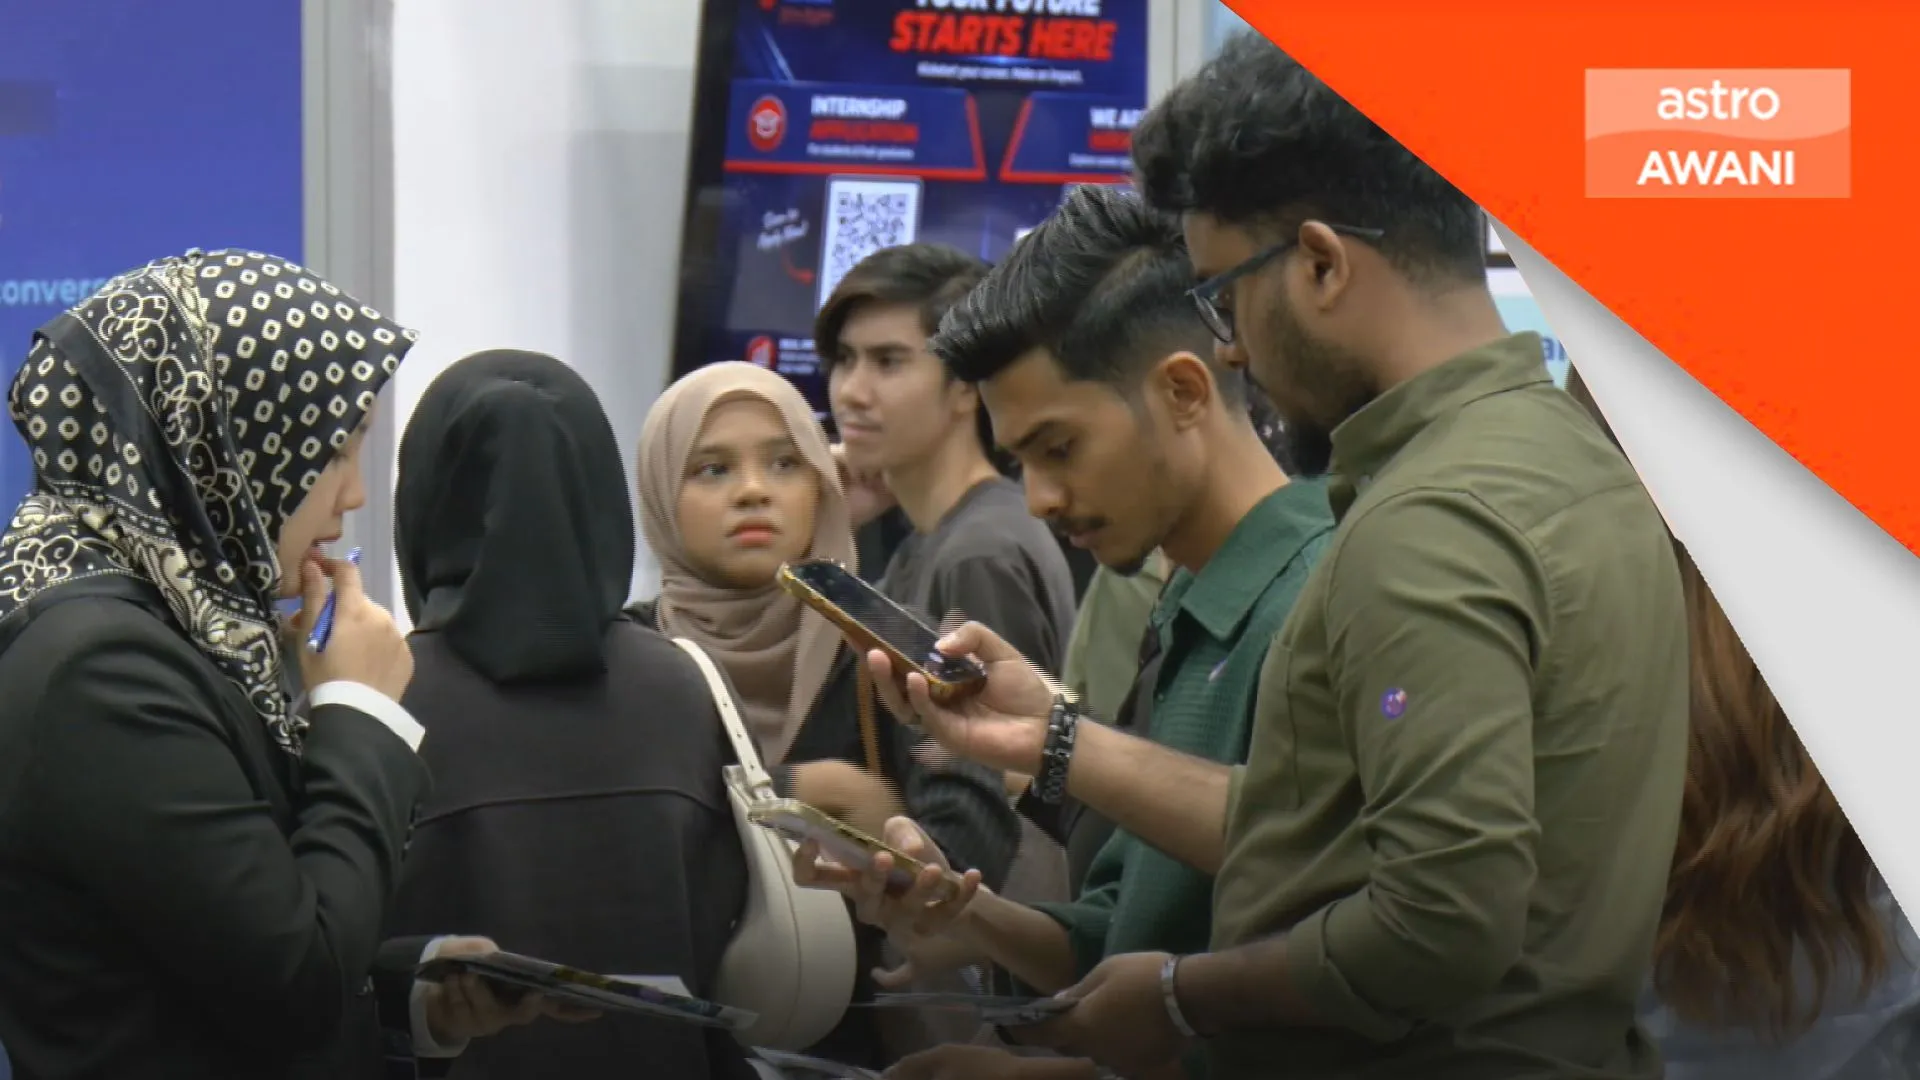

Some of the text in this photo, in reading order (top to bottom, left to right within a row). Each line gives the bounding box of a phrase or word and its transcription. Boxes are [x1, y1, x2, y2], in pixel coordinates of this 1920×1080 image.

[889, 11, 1117, 60] STARTS HERE
[811, 95, 907, 119] INTERNSHIP
[0, 278, 106, 306] onver
